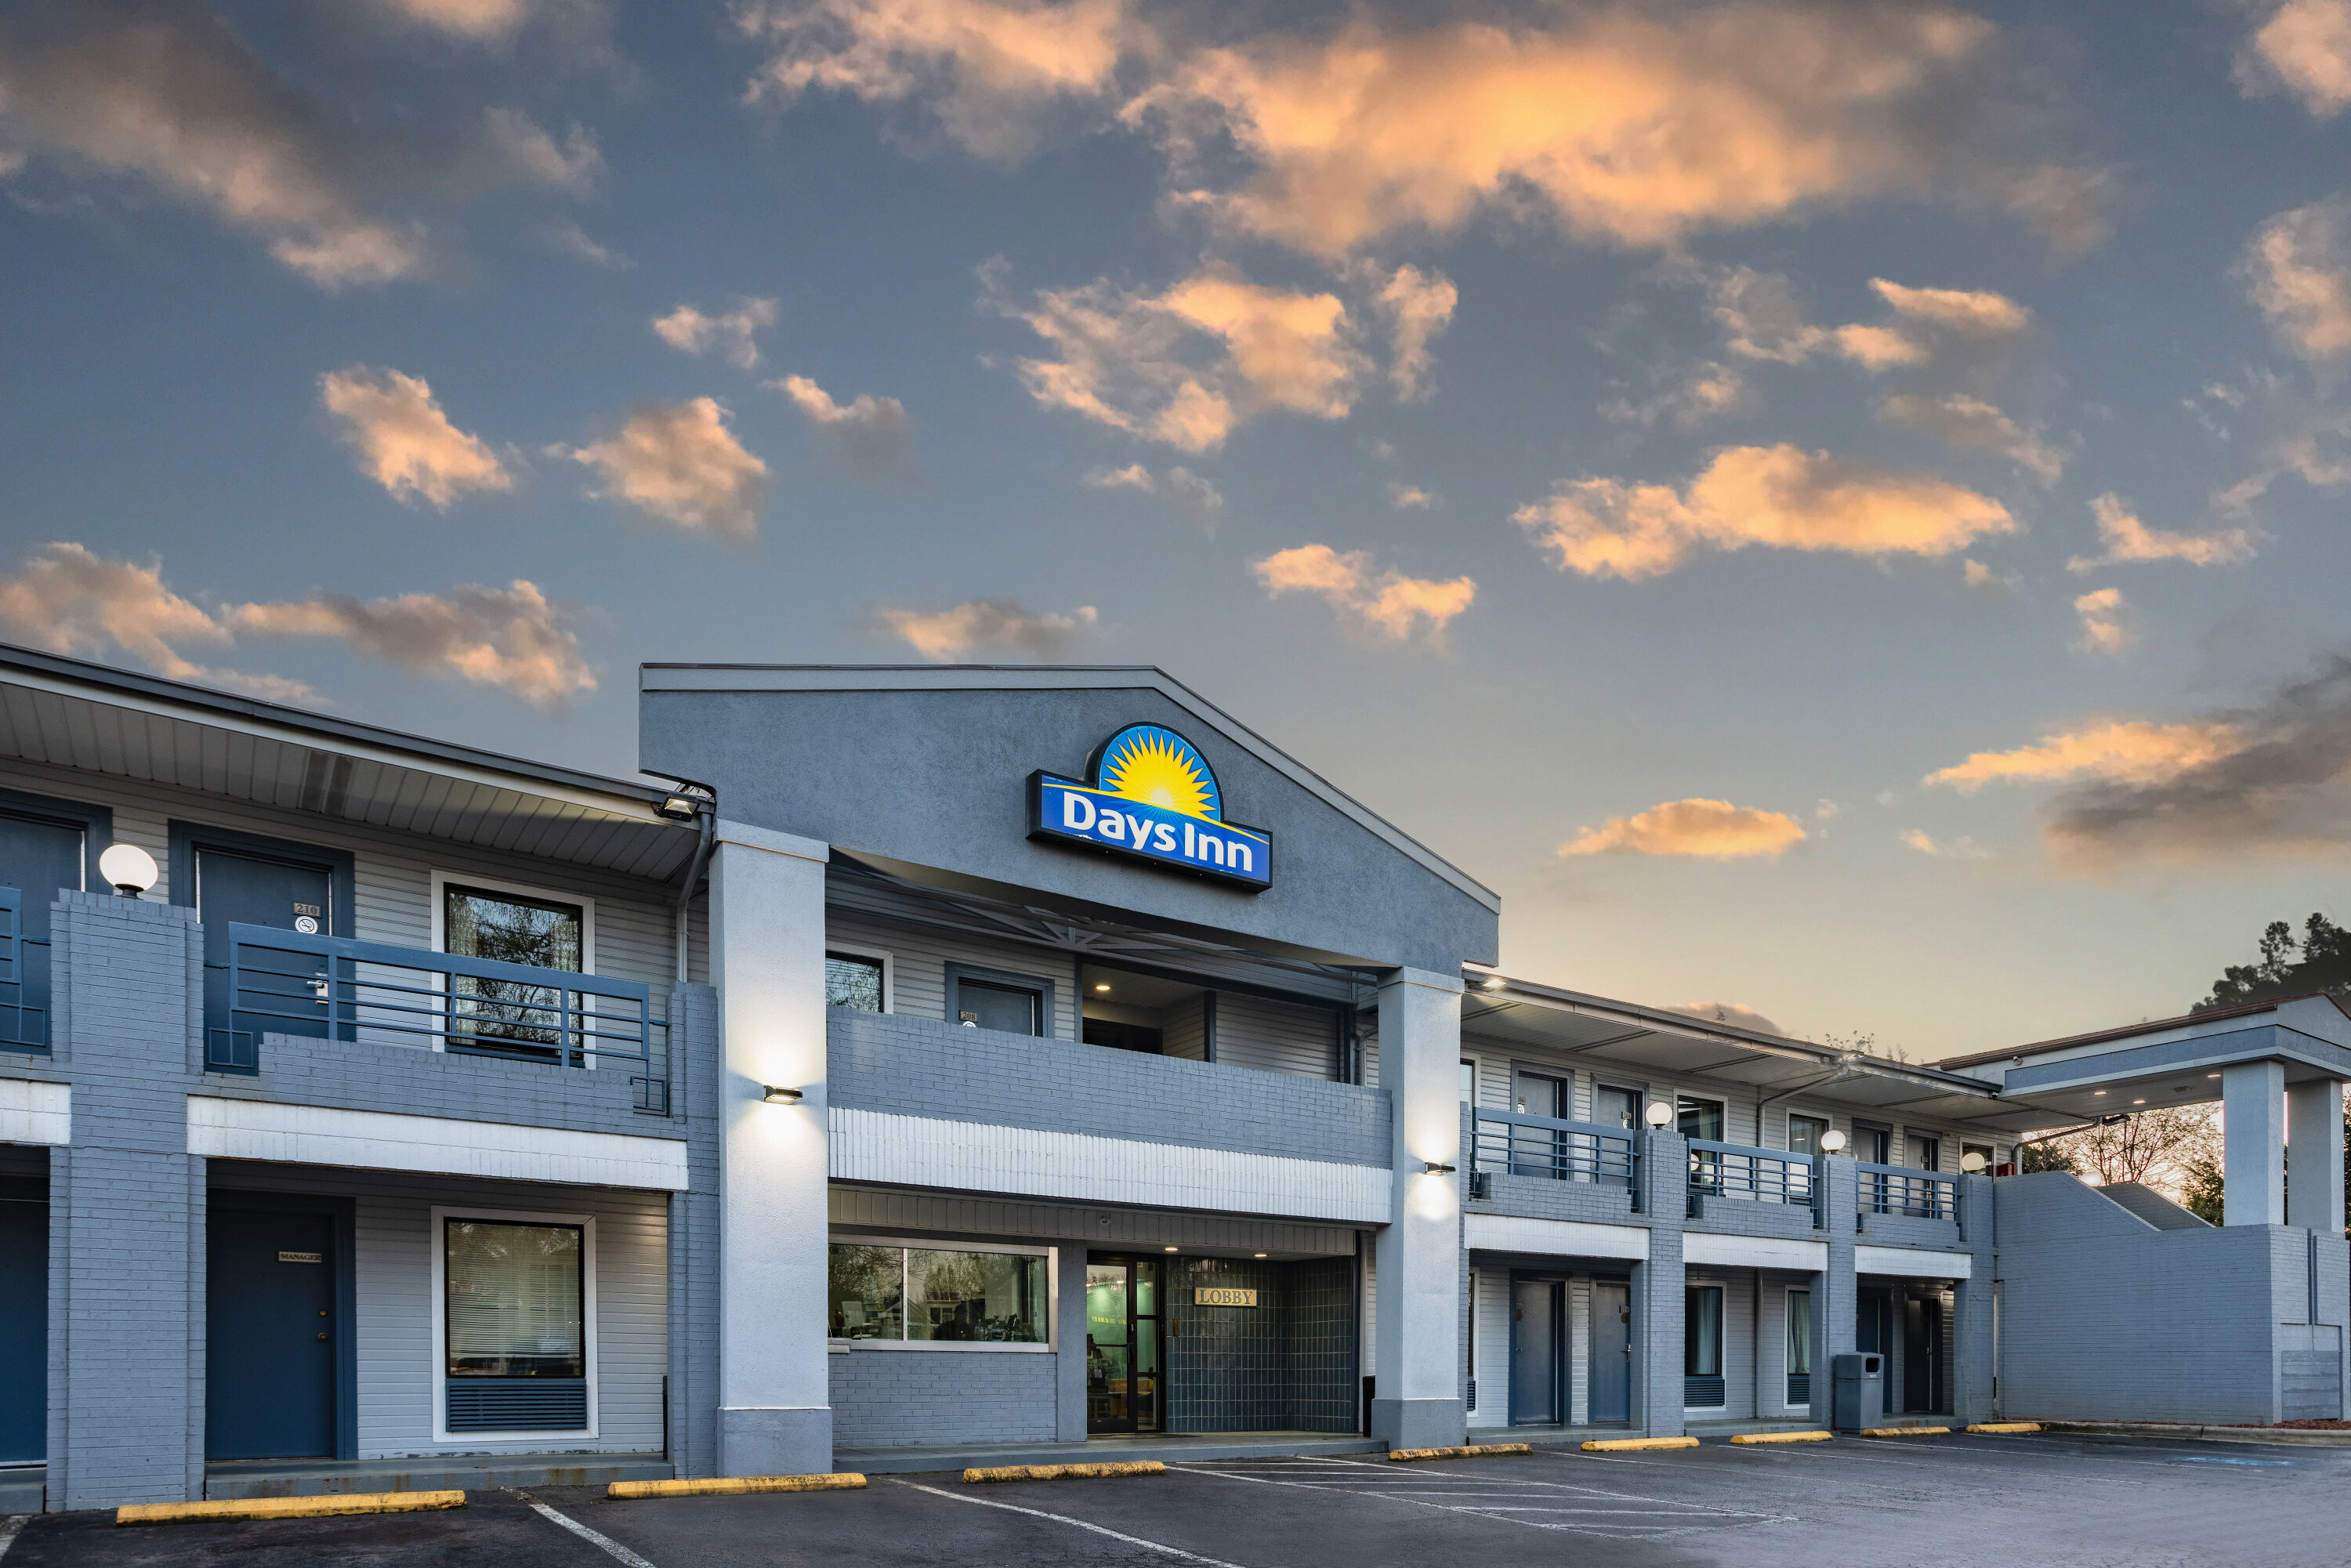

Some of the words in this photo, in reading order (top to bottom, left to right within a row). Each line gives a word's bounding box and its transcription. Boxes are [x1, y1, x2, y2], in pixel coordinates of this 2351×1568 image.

[1063, 791, 1176, 850] Days
[1184, 822, 1252, 872] Inn
[296, 904, 317, 915] 210
[962, 1012, 976, 1020] 208
[1198, 1289, 1253, 1305] LOBBY
